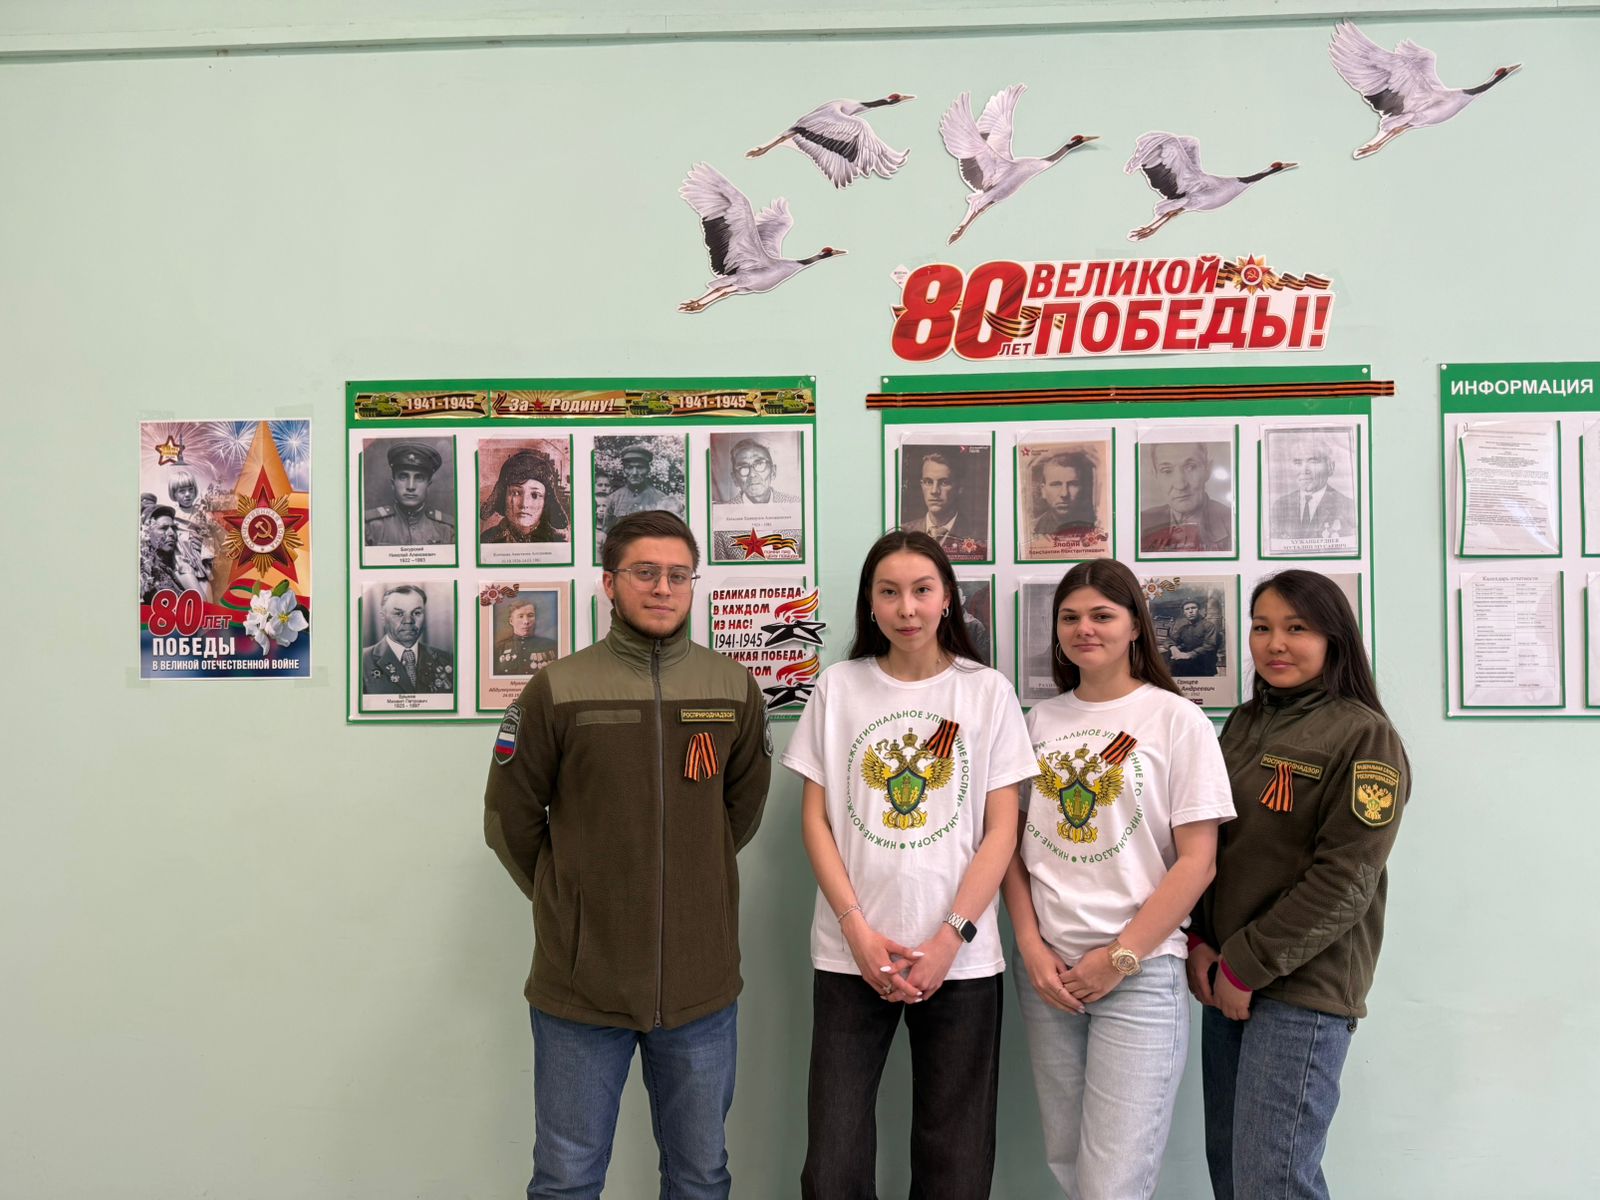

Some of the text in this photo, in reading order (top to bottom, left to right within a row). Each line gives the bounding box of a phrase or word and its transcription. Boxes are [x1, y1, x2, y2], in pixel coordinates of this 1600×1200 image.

[1028, 254, 1221, 299] ВЕЛИКОЙ
[889, 259, 1029, 362] 80
[1032, 295, 1332, 356] ПОБЕДЫ!
[997, 342, 1032, 356] ЛЕТ
[1450, 378, 1594, 397] ИНФОРМАЦИЯ
[406, 396, 475, 411] 1941-1945
[509, 397, 615, 413] За Родину!
[678, 394, 747, 409] 1941-1945
[712, 588, 757, 601] ВЕЛИКАЯ
[148, 588, 204, 637] 80
[712, 602, 771, 616] В КАЖДОМ
[201, 614, 233, 630] ЛЕТ
[713, 618, 753, 631] ИЗ НАС!
[152, 636, 236, 659] ПОБЕДЫ
[714, 632, 763, 649] 1941-1945
[152, 656, 300, 671] В ВЕЛИКОЙ ОТЕЧЕСТВЕННОЙ ВОЙНЕ
